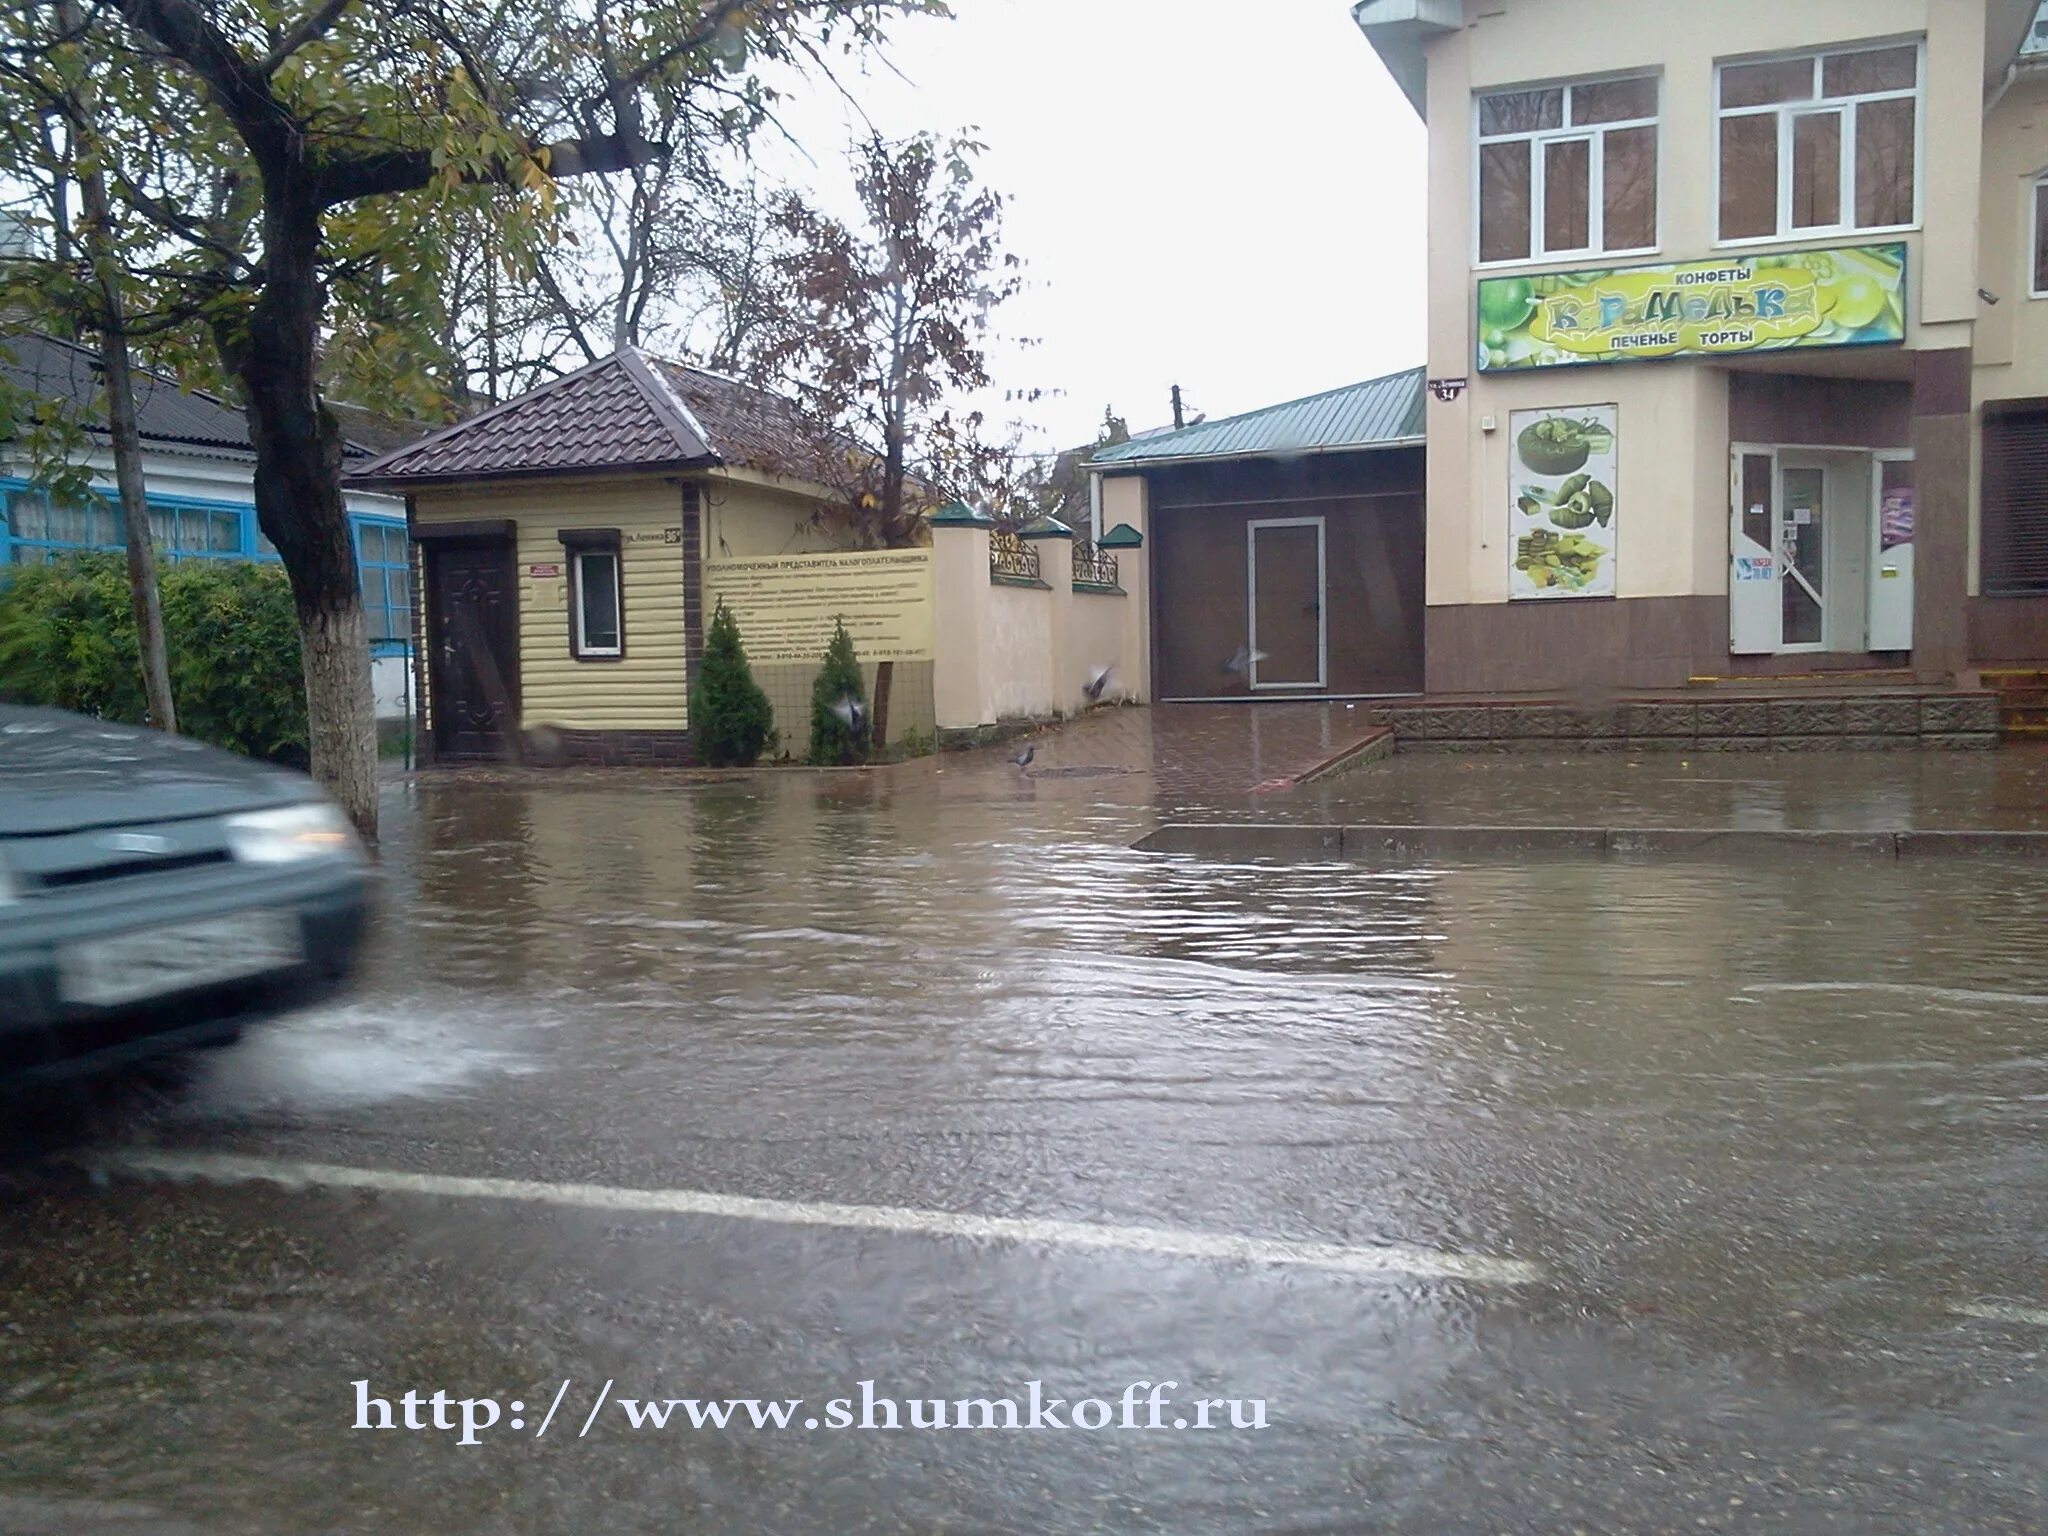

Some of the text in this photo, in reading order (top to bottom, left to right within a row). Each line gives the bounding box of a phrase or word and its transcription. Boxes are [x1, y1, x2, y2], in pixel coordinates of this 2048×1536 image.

[1675, 268, 1751, 285] КОНФЕТЫ
[1611, 331, 1753, 348] ПЕЧЕНЬЕ ТОРТЫ
[1441, 388, 1454, 400] 34
[780, 558, 837, 570] ПРЕДСТАВИТЕЛЬ
